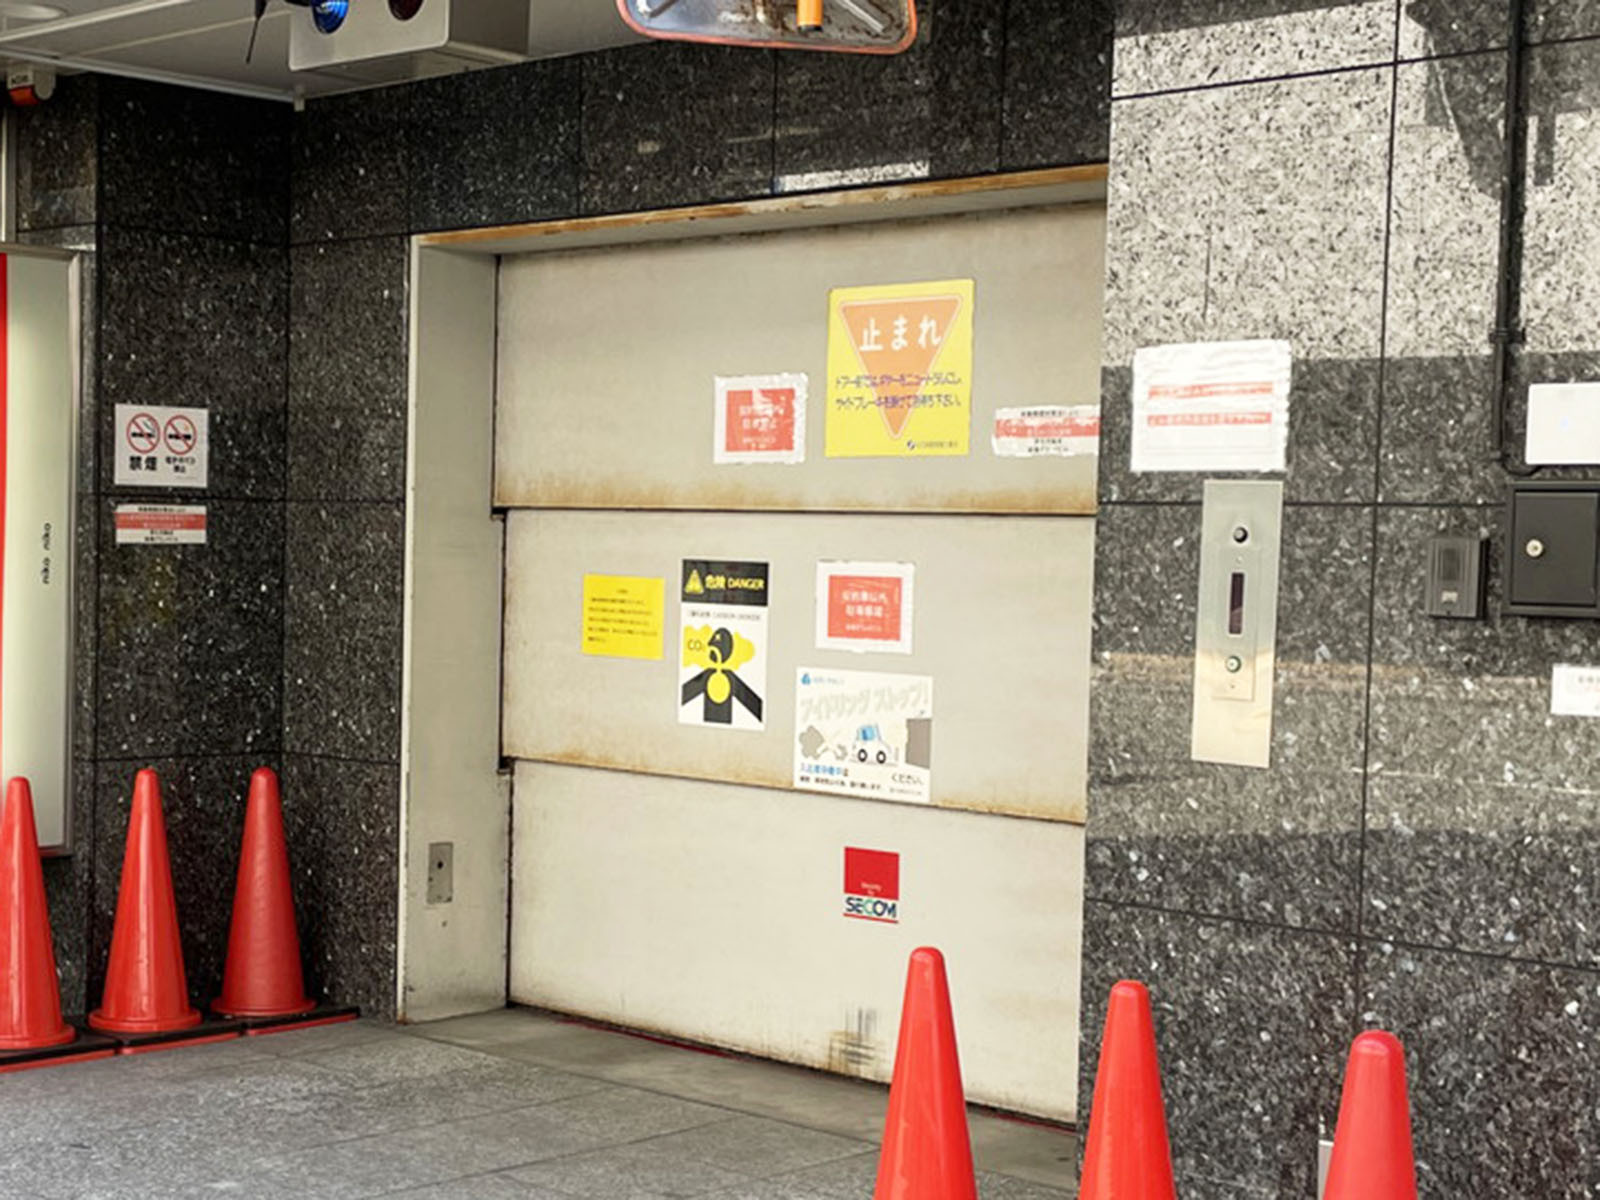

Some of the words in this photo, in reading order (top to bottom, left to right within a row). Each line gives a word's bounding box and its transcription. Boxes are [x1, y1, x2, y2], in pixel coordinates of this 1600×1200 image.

[859, 314, 942, 351] 止まれ
[727, 577, 765, 591] DANGER
[845, 896, 897, 918] SECOM
